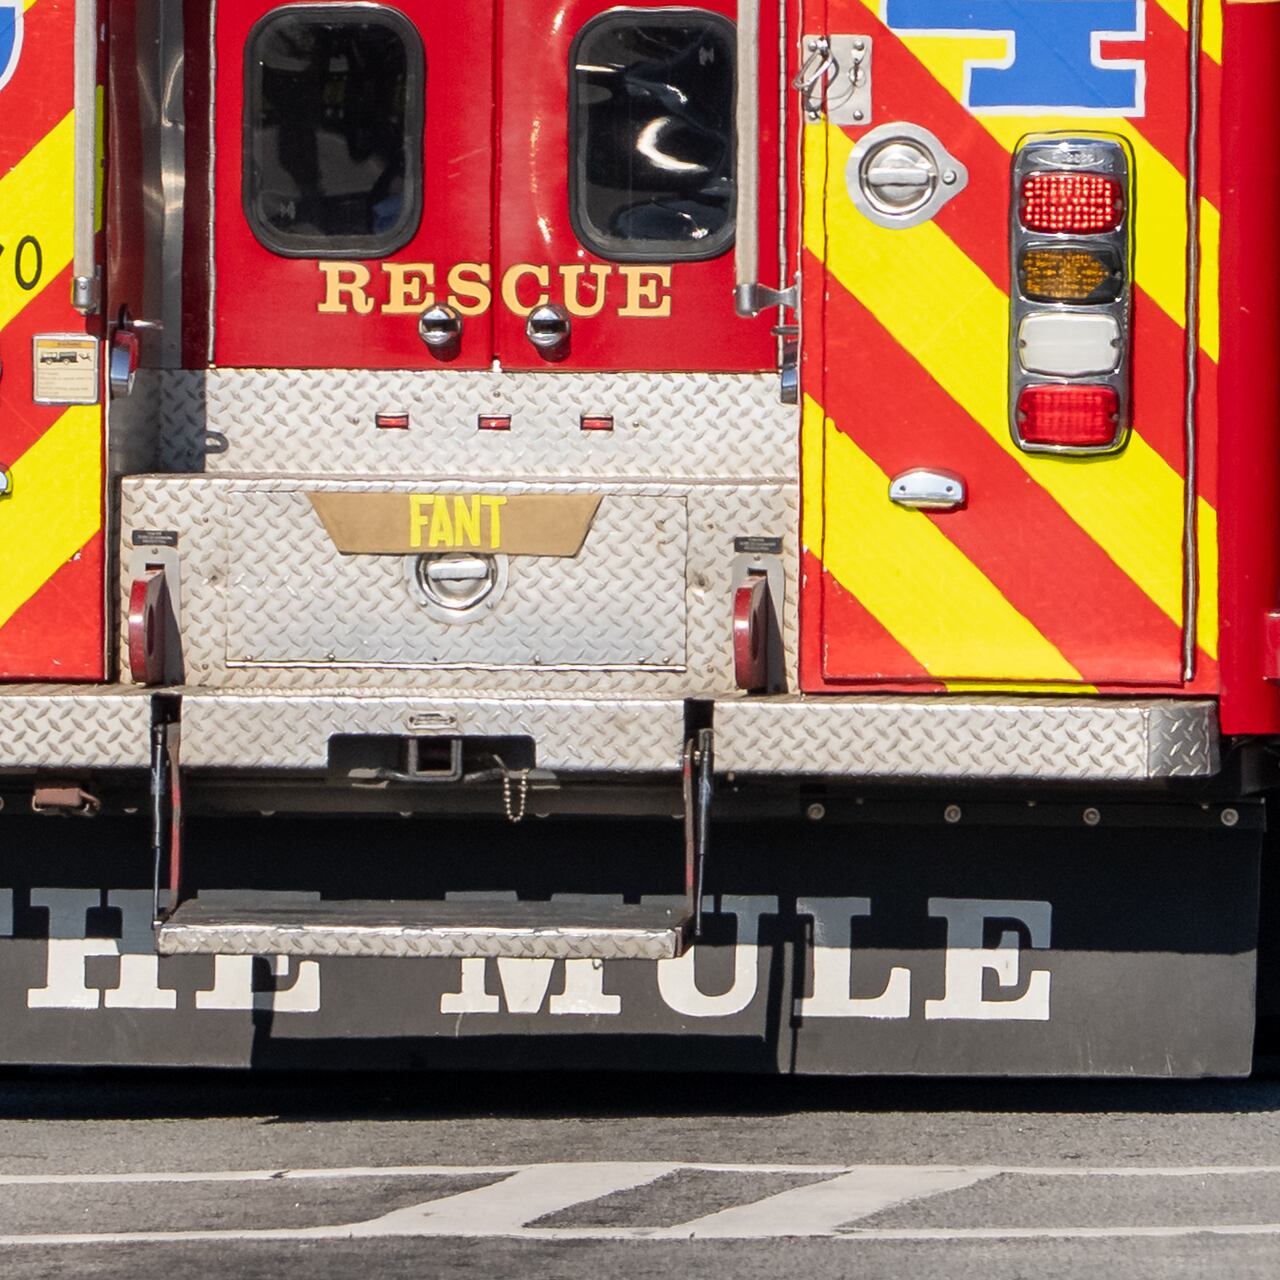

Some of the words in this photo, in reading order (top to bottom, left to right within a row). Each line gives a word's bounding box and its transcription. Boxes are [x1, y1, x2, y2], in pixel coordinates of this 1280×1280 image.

[317, 261, 673, 319] RESCUE
[409, 494, 508, 550] FANT
[440, 889, 1052, 1020] MULE
